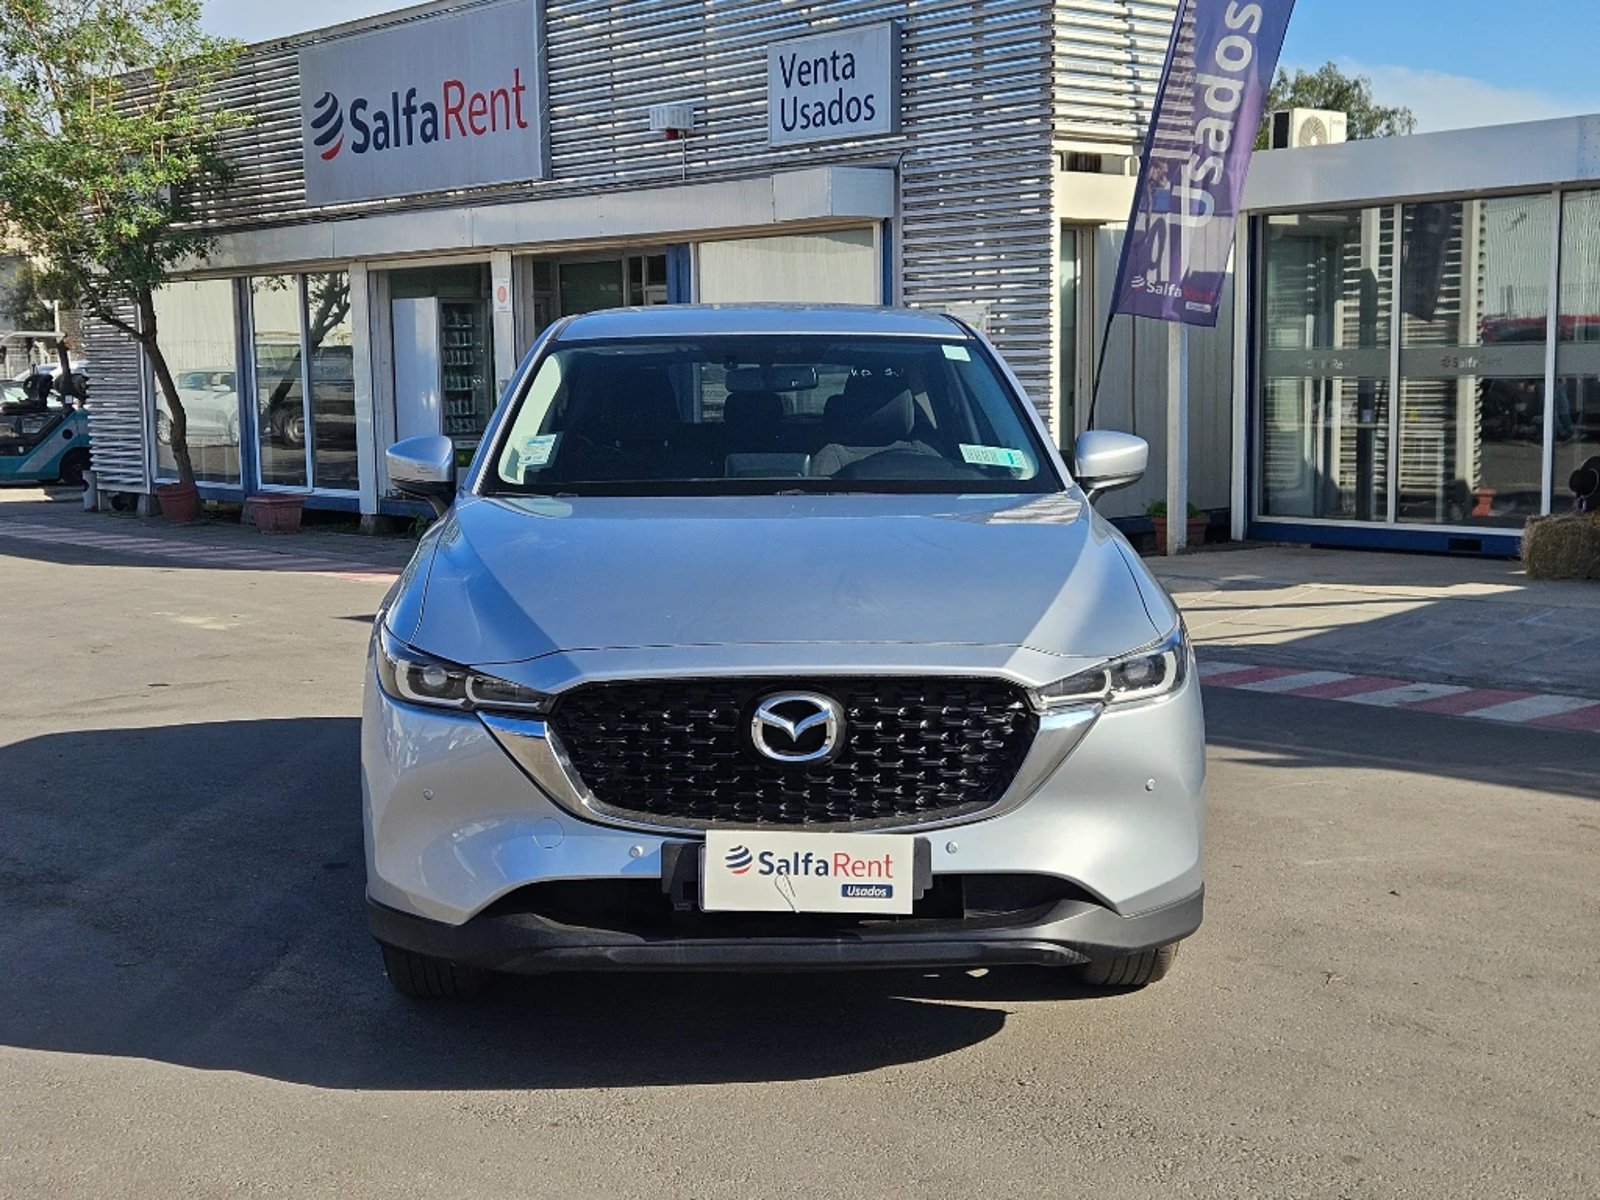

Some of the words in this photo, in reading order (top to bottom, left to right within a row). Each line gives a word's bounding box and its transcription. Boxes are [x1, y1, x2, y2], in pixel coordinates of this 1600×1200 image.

[779, 49, 856, 89] Venta
[349, 67, 529, 155] SalfaRent
[780, 87, 876, 132] Usados
[1172, 0, 1263, 228] Usados
[758, 850, 894, 879] SalfaRent
[847, 885, 887, 897] Usados
